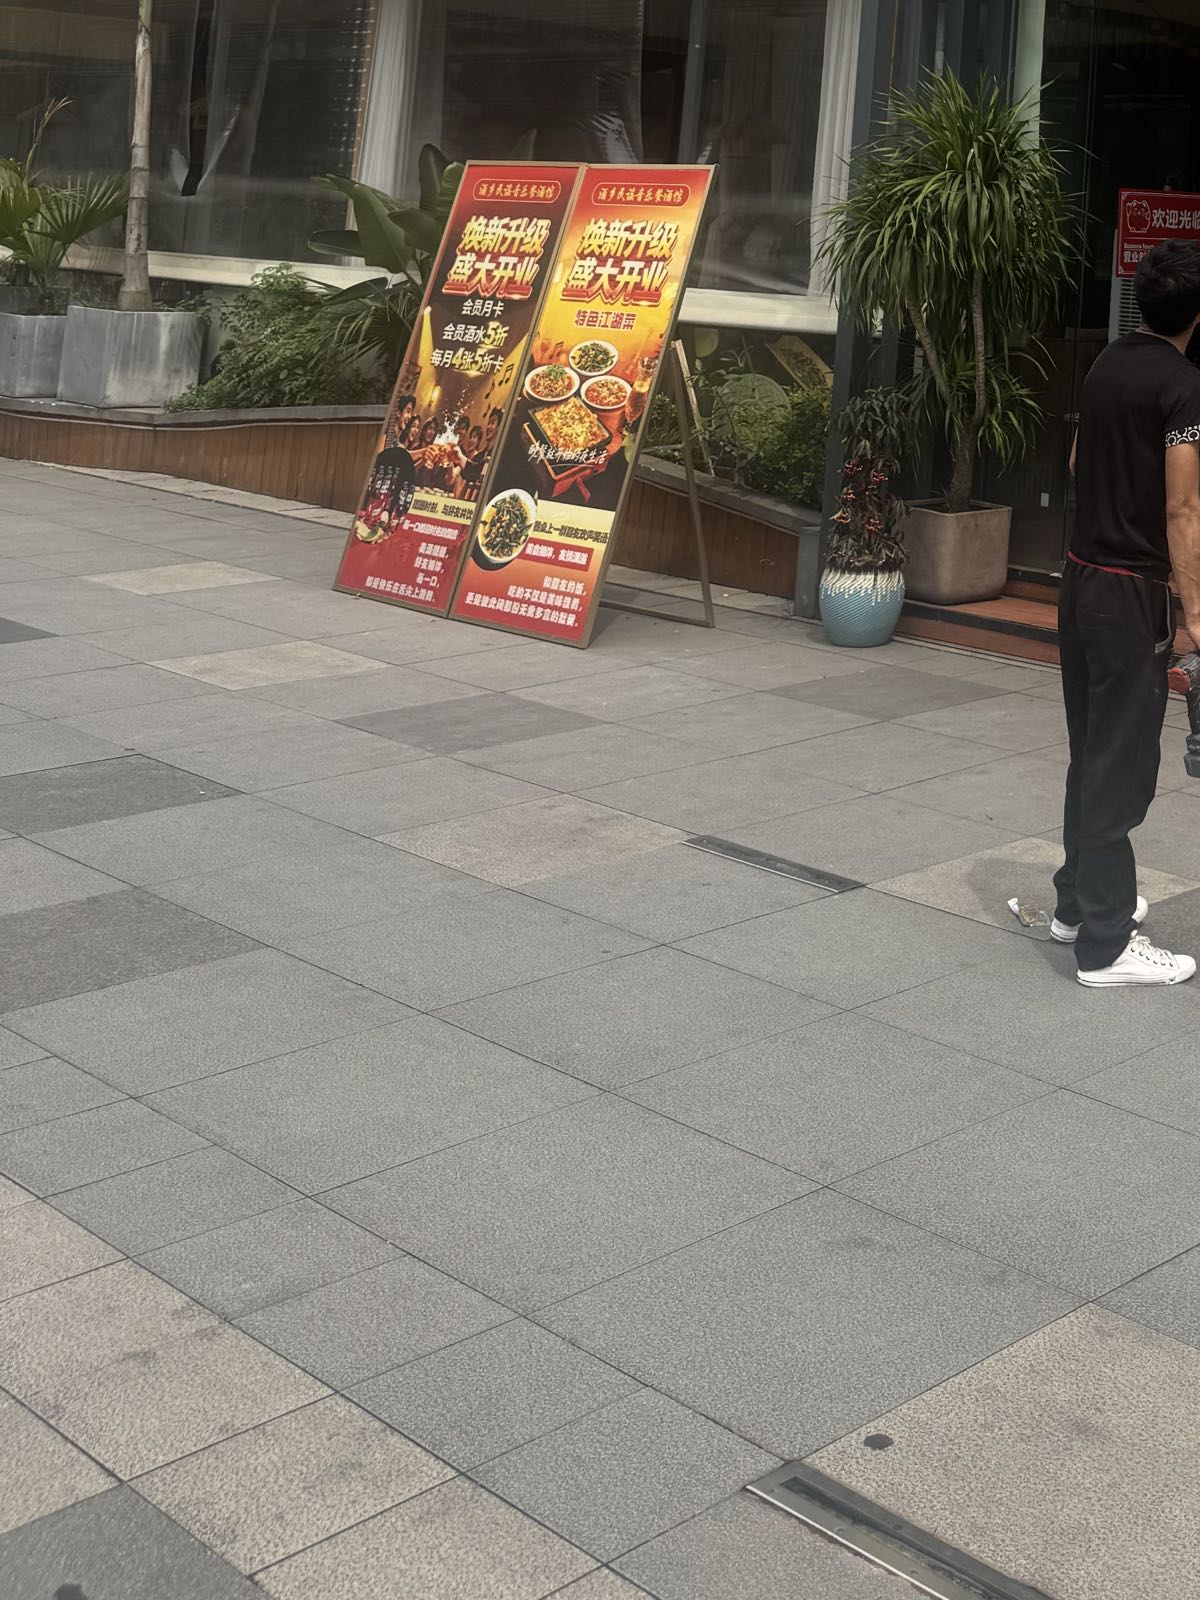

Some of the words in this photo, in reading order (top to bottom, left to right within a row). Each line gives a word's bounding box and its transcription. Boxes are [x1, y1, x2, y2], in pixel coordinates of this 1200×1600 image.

[462, 216, 550, 256] 焕新升级
[578, 219, 679, 261] 焕新升级
[446, 253, 540, 295] 盛大开业
[562, 257, 670, 302] 盛大开业
[461, 298, 504, 318] 会员月卡
[574, 308, 637, 331] 特色江湖菜
[442, 320, 509, 347] 会员酒水5折
[430, 347, 505, 374] 每月4张5折卡
